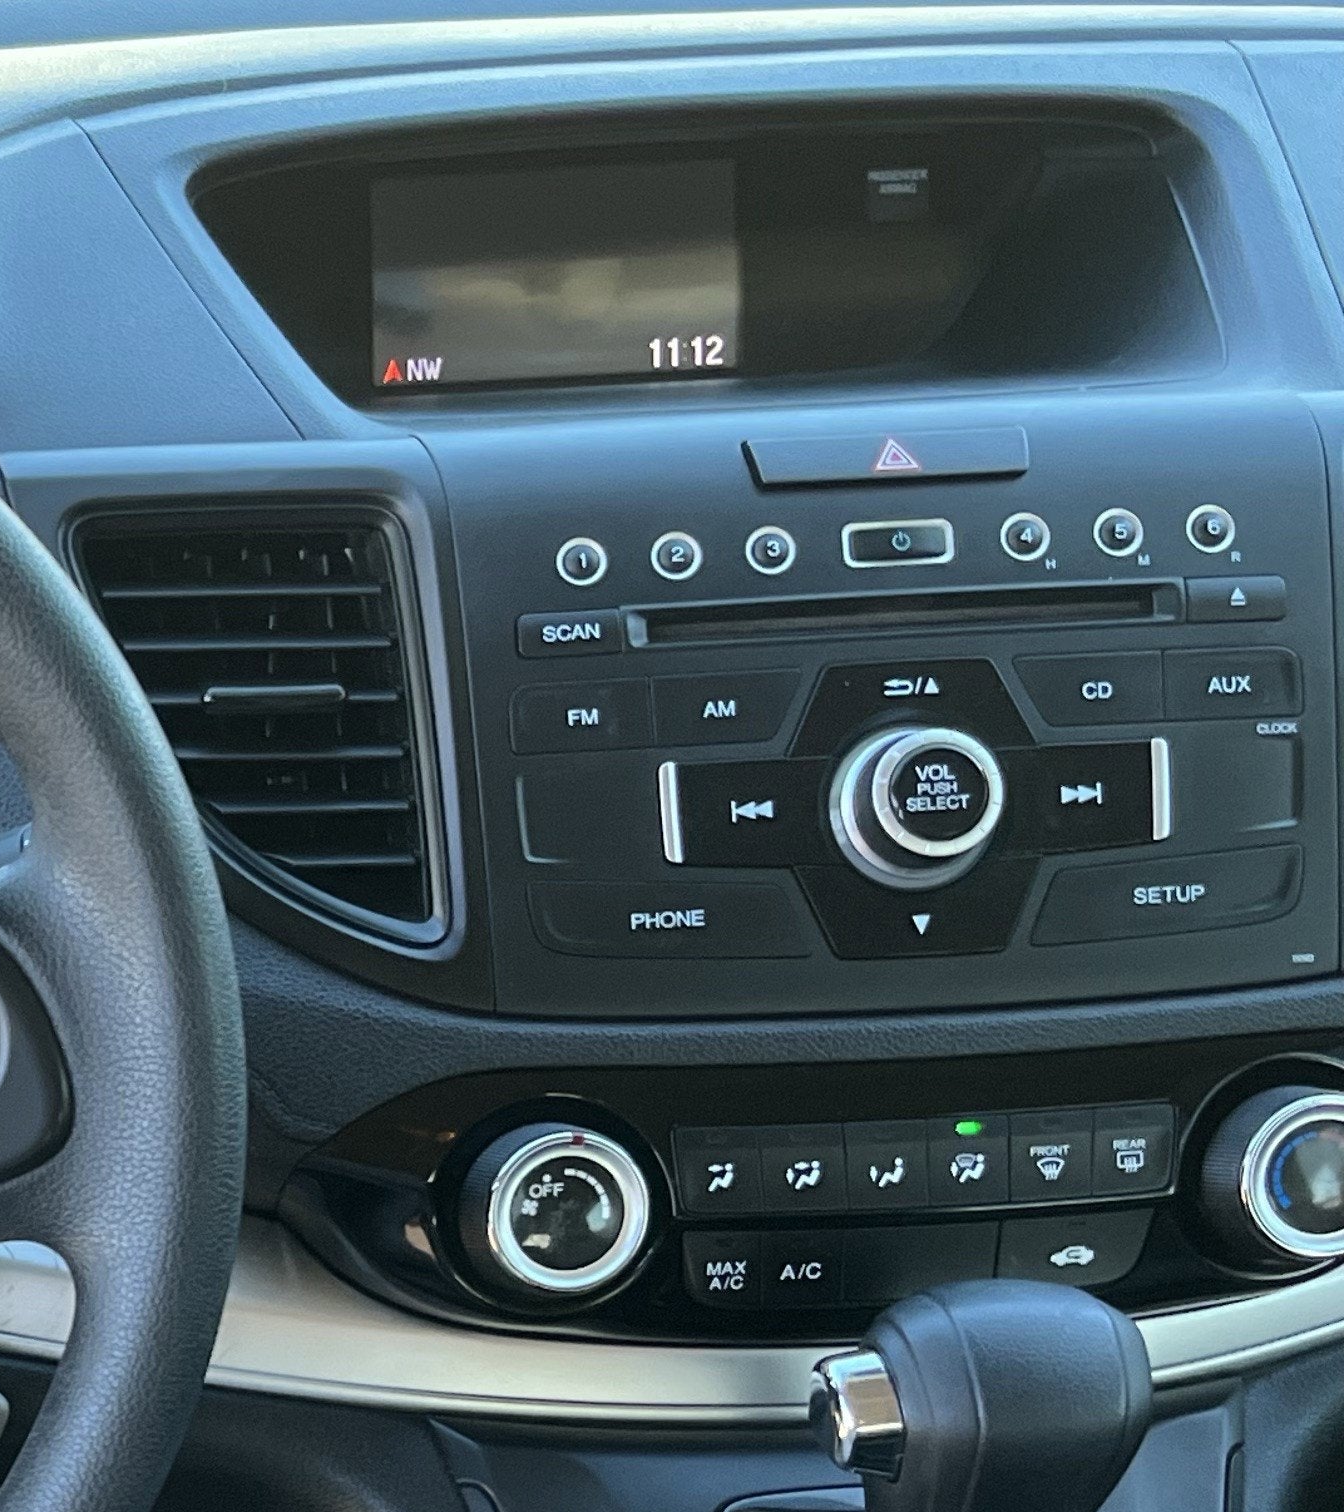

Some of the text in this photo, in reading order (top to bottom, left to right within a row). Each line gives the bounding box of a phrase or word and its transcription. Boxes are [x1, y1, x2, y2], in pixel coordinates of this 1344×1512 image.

[649, 335, 723, 368] 11:12
[406, 356, 443, 381] NW
[1020, 528, 1033, 544] 4
[1115, 524, 1127, 540] 5
[1206, 520, 1219, 535] 6
[671, 547, 686, 563] 2
[766, 540, 780, 557] 3
[578, 553, 587, 569] 1
[542, 623, 601, 643] SCAN
[1081, 681, 1113, 700] CD
[1208, 676, 1251, 694] AUX
[567, 708, 599, 727] FM
[702, 701, 736, 719] AM
[1255, 722, 1298, 735] CLOCK
[915, 764, 956, 781] VOL
[917, 782, 957, 795] PUSH
[906, 795, 970, 811] SELECT
[1133, 885, 1206, 905] SETUP
[630, 909, 706, 930] PHONE
[1030, 1144, 1070, 1157] FRONT
[1112, 1138, 1147, 1151] REAR
[529, 1182, 565, 1200] OFF
[706, 1260, 747, 1277] MAX
[780, 1262, 822, 1281] A/C
[709, 1274, 745, 1290] A/C
